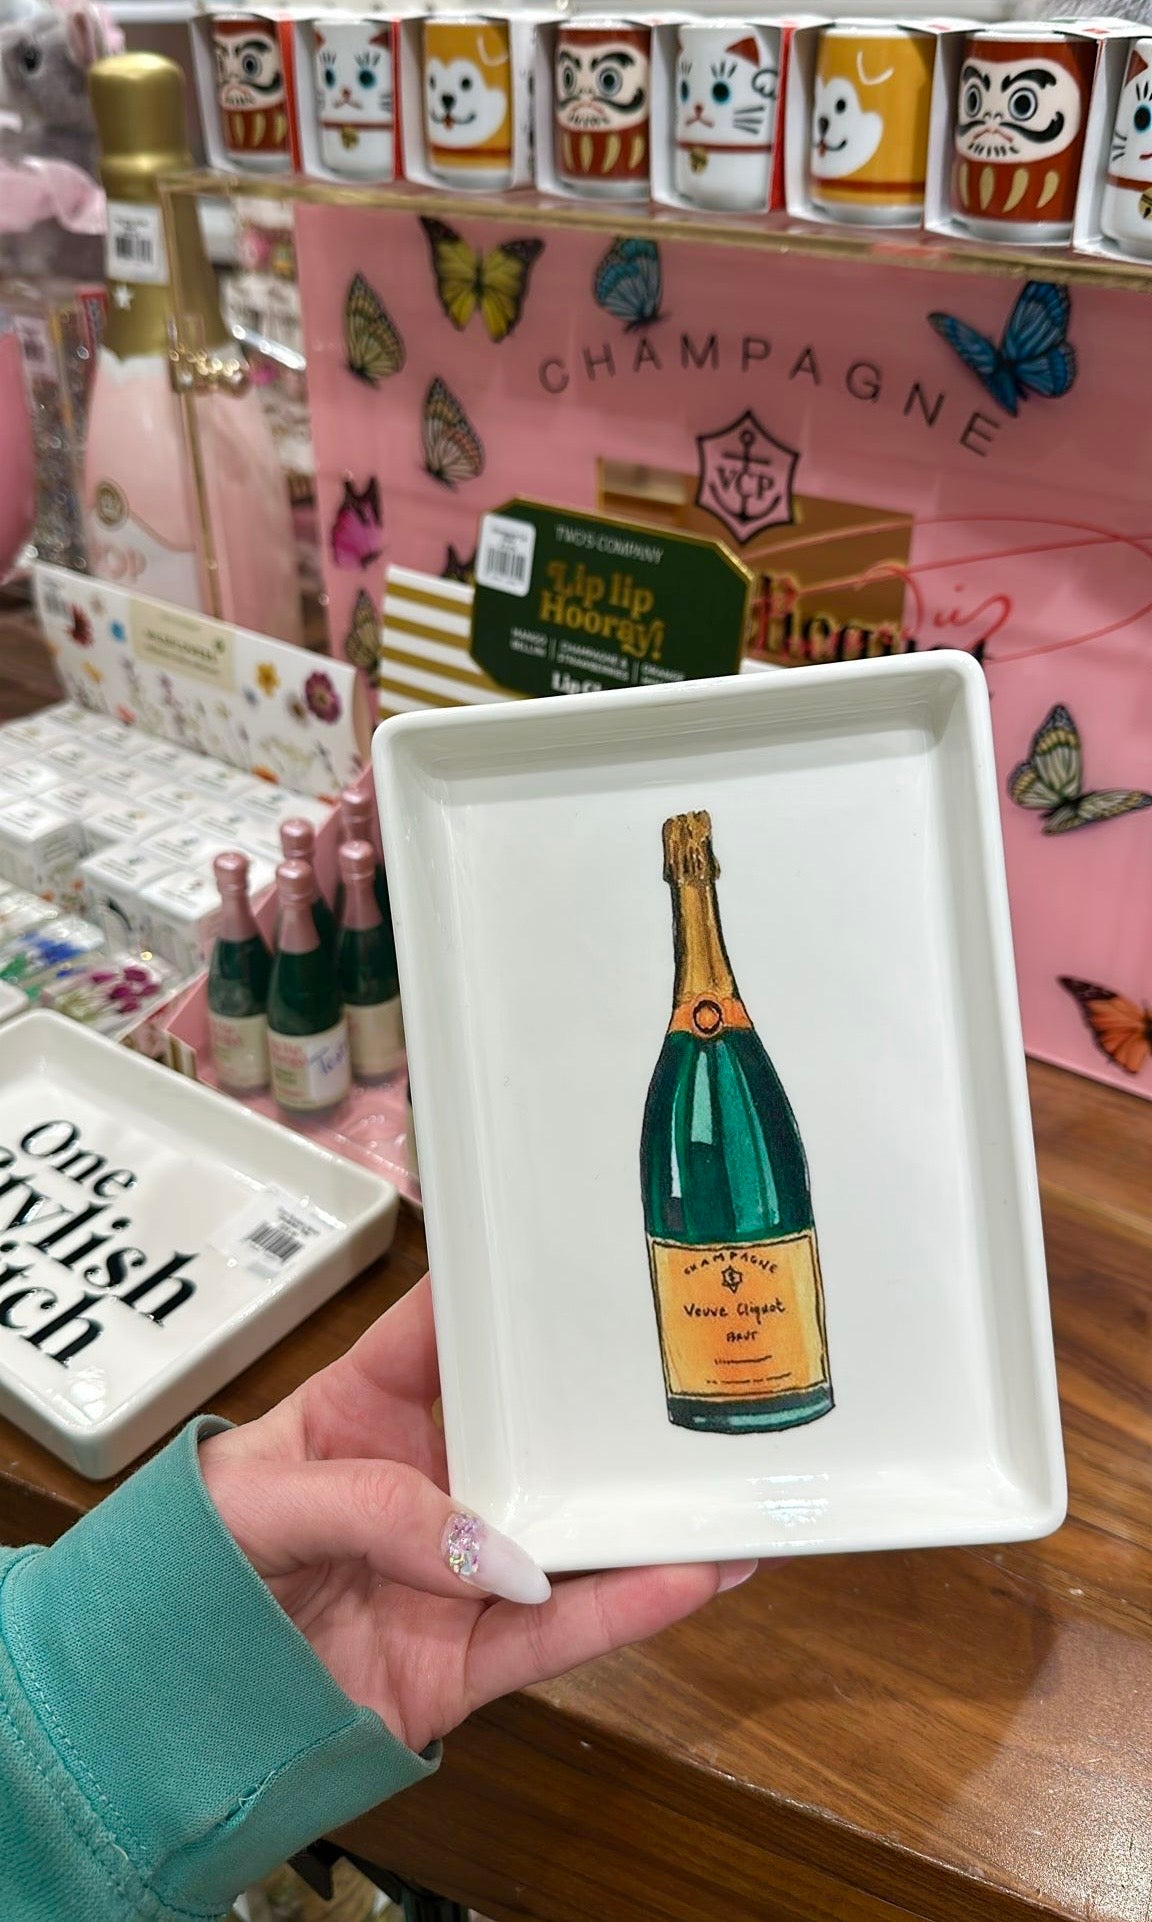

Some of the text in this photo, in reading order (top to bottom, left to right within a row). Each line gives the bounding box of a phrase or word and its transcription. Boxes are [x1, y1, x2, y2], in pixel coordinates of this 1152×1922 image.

[538, 334, 1000, 457] CHAMPAGNE
[600, 536, 664, 565] COMPANY
[547, 561, 655, 620] Lip lip
[539, 590, 665, 660] Hooray!
[20, 1120, 137, 1199] One
[0, 1147, 200, 1327] tylish
[684, 1251, 778, 1275] CHAMPAGNE
[684, 1303, 729, 1317] Veuve
[726, 1331, 759, 1343] BRUT
